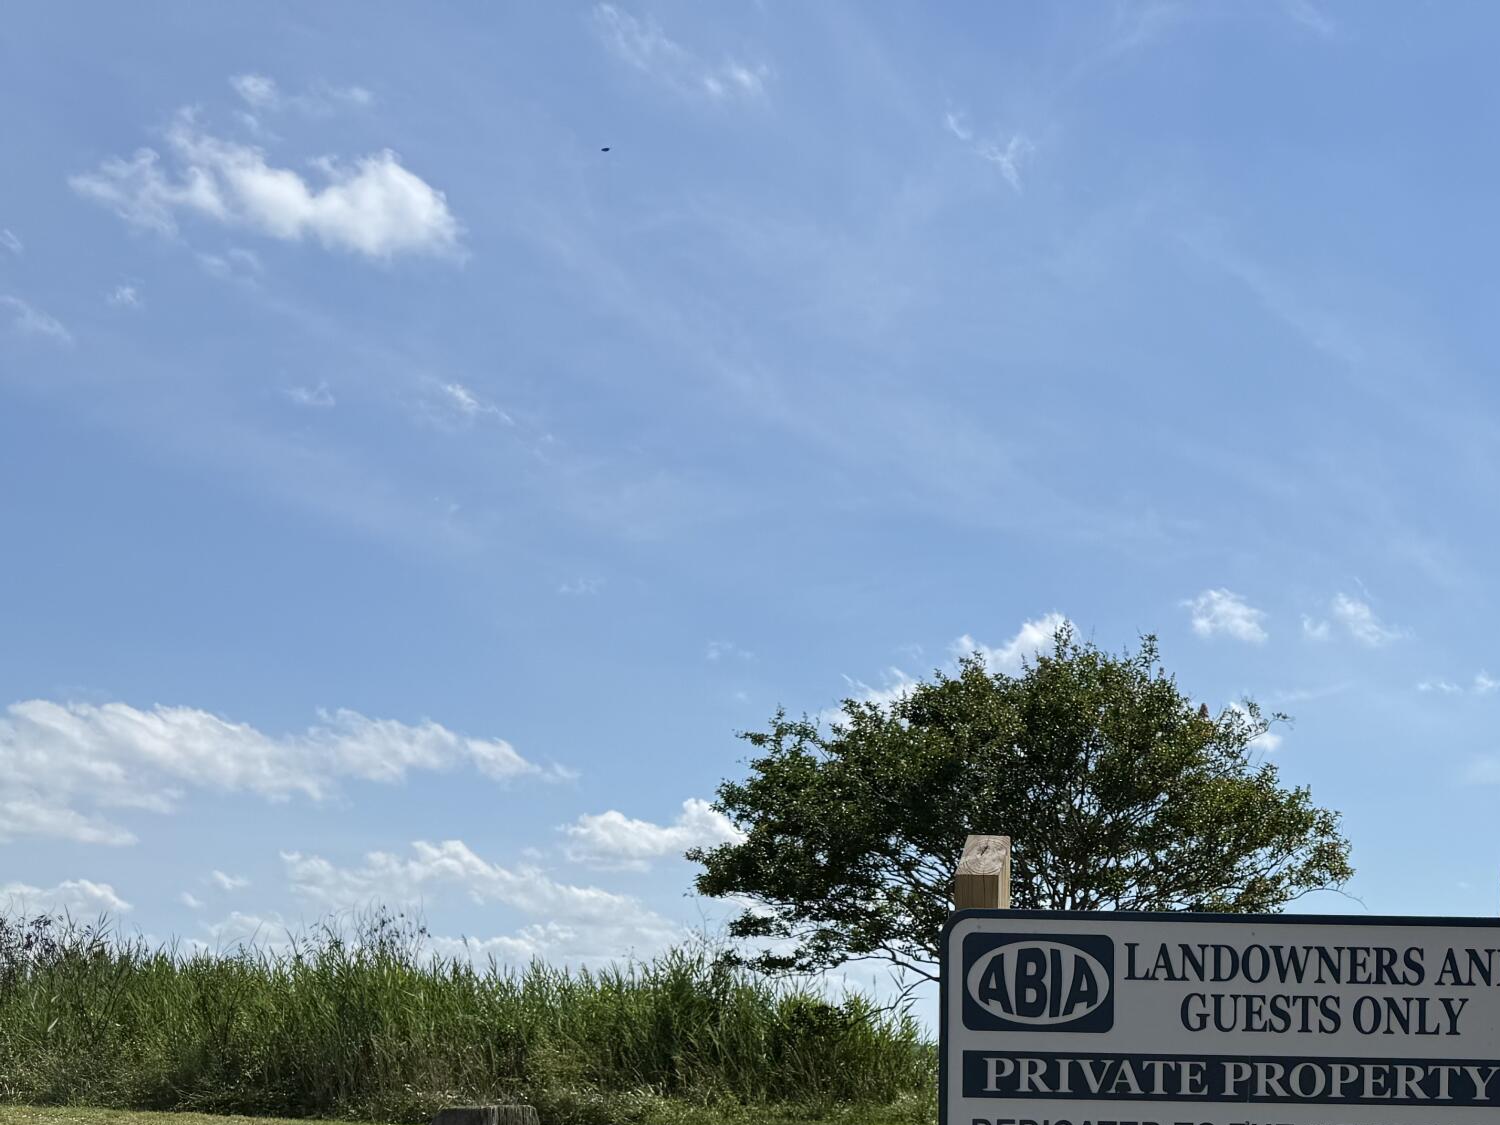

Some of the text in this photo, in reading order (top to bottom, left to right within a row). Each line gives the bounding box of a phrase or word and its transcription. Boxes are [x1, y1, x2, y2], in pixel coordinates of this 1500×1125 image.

[978, 946, 1099, 1019] ABIA
[1123, 942, 1425, 986] LANDOWNERS
[1179, 993, 1469, 1036] GUESTS ONLY
[981, 1057, 1500, 1101] PRIVATE PROPERTY
